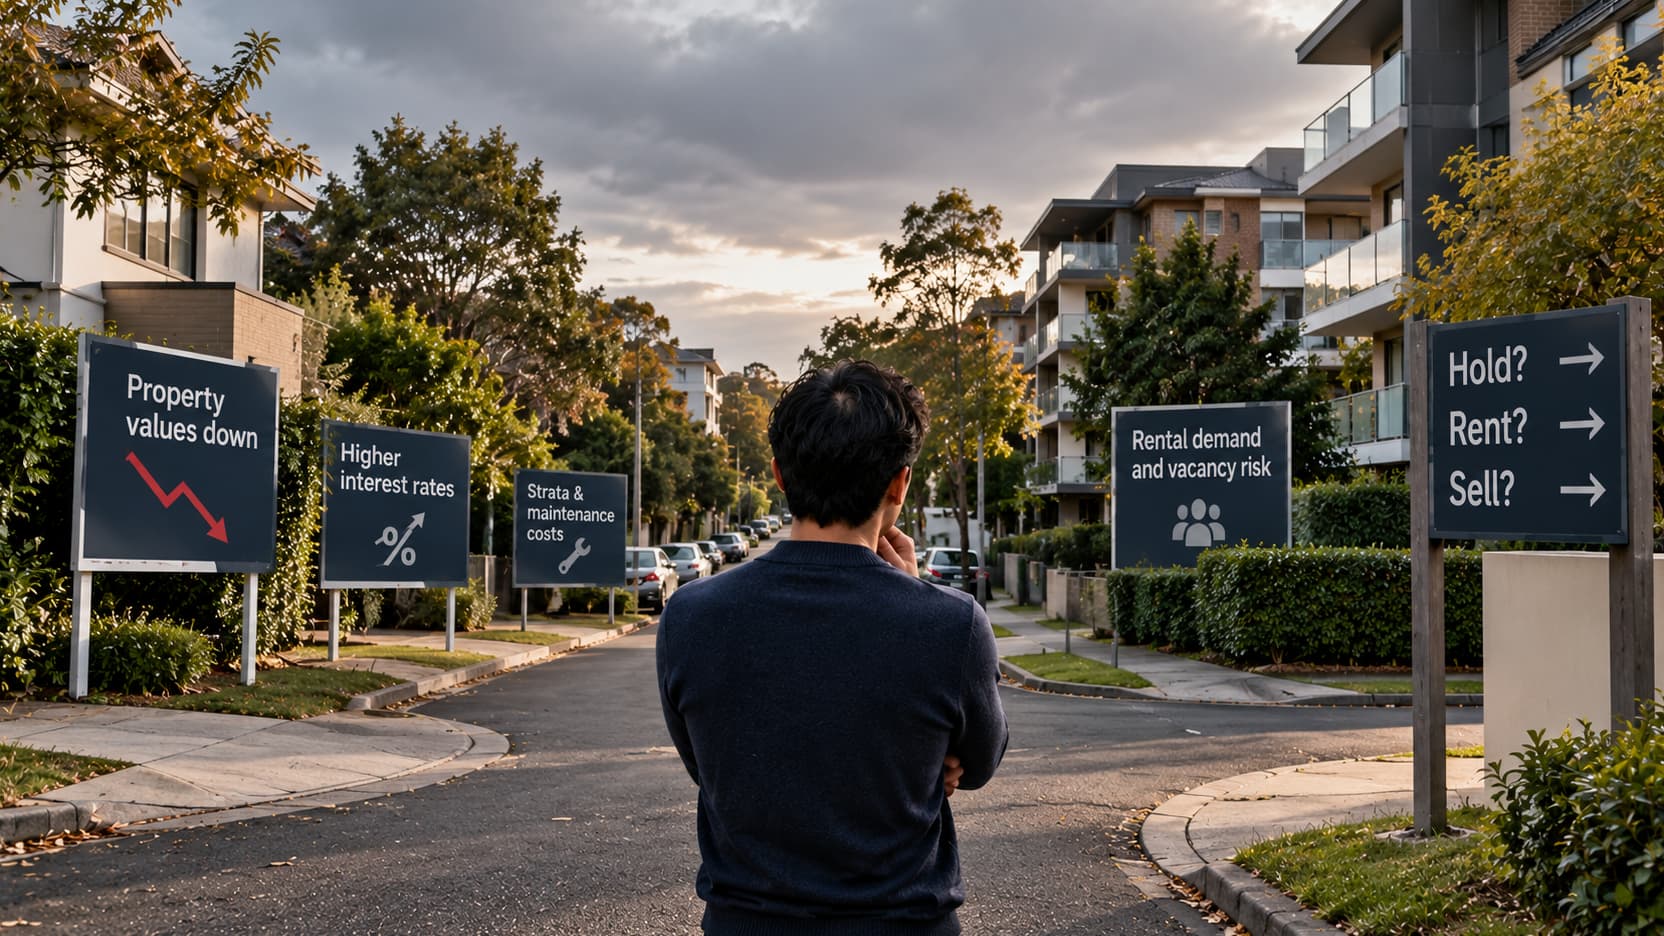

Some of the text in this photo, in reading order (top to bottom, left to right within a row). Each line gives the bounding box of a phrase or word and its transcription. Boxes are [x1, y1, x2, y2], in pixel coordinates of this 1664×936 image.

[1449, 345, 1527, 386] Hold?
[128, 374, 224, 417] Property
[126, 413, 258, 450] values down
[1132, 426, 1261, 451] Rental demand
[1450, 407, 1527, 445] Rent?
[341, 443, 401, 470] Higher
[1132, 455, 1271, 482] and vacancy risk
[340, 470, 455, 498] interest rates
[527, 483, 584, 501] Strata &
[1449, 470, 1514, 507] Sell?
[527, 505, 615, 523] maintenance
[527, 527, 564, 542] costs
